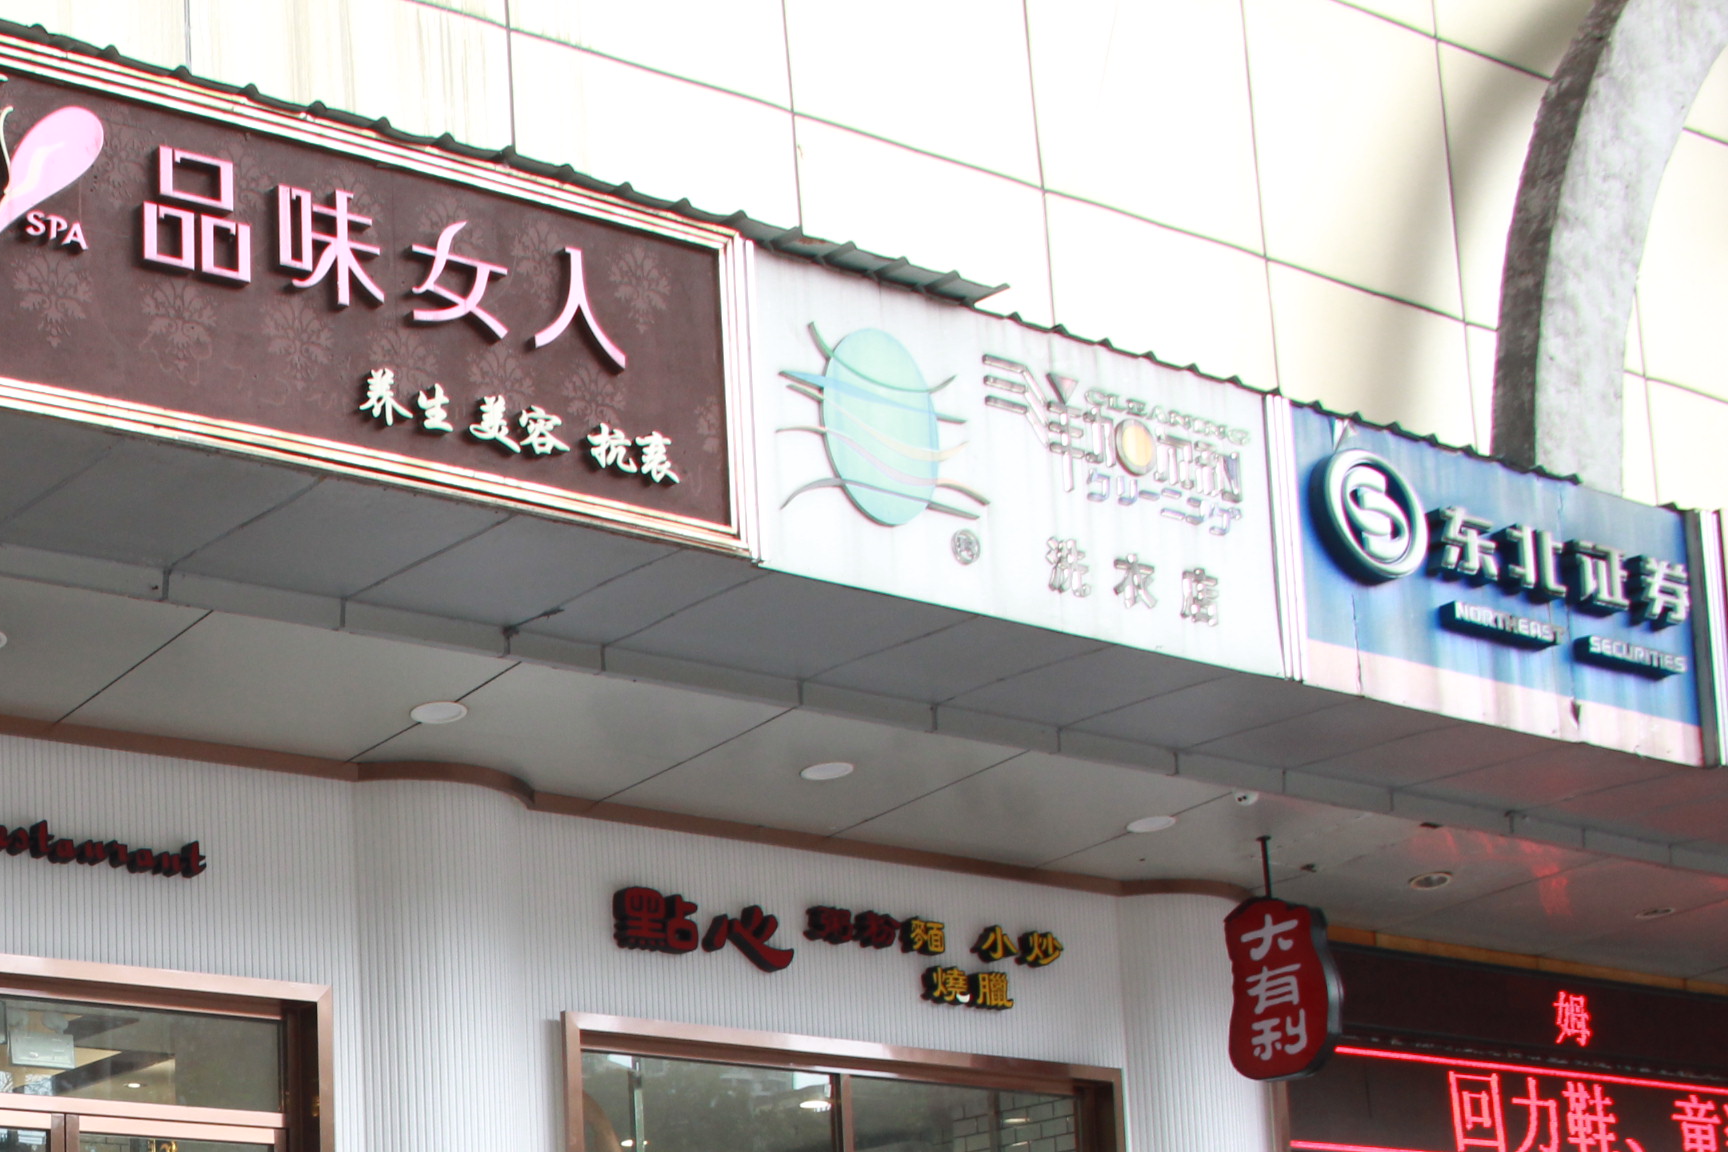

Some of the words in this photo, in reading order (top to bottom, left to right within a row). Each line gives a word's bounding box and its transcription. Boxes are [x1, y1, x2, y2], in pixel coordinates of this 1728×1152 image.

[25, 210, 89, 252] SPA
[142, 143, 627, 372] 品味女人
[1045, 536, 1219, 627] 洗衣店
[1438, 505, 1691, 626] 东北证券
[1454, 600, 1565, 646] NORTHEAST
[1588, 635, 1688, 674] SECURITIES
[613, 886, 795, 973] 點心
[1240, 912, 1309, 1061] 大有利
